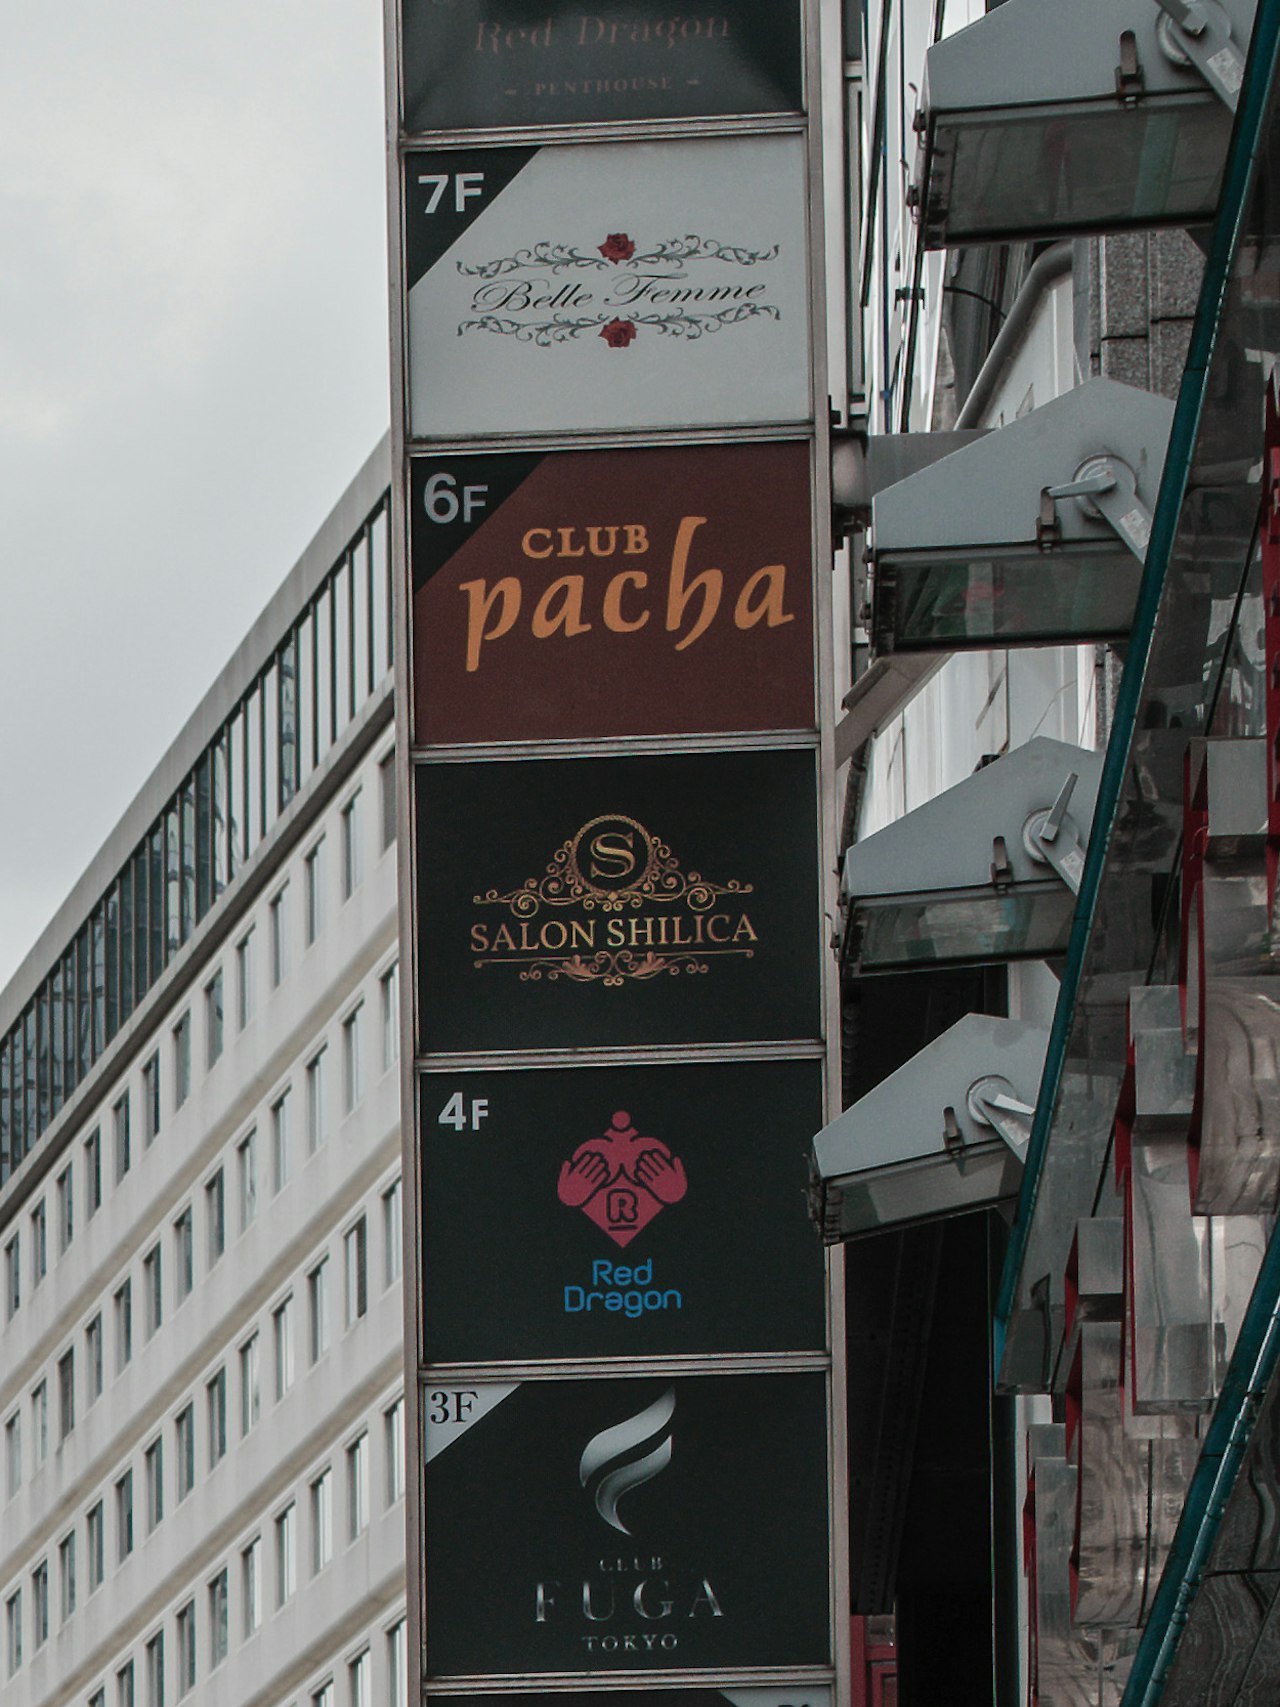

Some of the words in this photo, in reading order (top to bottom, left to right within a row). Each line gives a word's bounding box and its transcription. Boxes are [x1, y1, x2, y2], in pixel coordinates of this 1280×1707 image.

[476, 18, 555, 53] Red
[577, 14, 731, 49] Dragon
[535, 77, 672, 97] PENTHOUSE
[418, 172, 485, 214] 7F
[471, 278, 594, 314] Belle
[604, 272, 766, 306] Femme
[424, 473, 489, 524] 6F
[521, 524, 651, 559] CLUB
[459, 516, 794, 672] pacha
[470, 918, 596, 953] SALON
[606, 913, 759, 948] SHILICA
[438, 1091, 489, 1131] 4F
[592, 1258, 653, 1287] Red
[564, 1285, 682, 1318] Dragon
[430, 1391, 479, 1424] 3F
[598, 1556, 664, 1572] CLUB
[535, 1577, 725, 1623] FUGA
[582, 1633, 679, 1652] TOKYO
